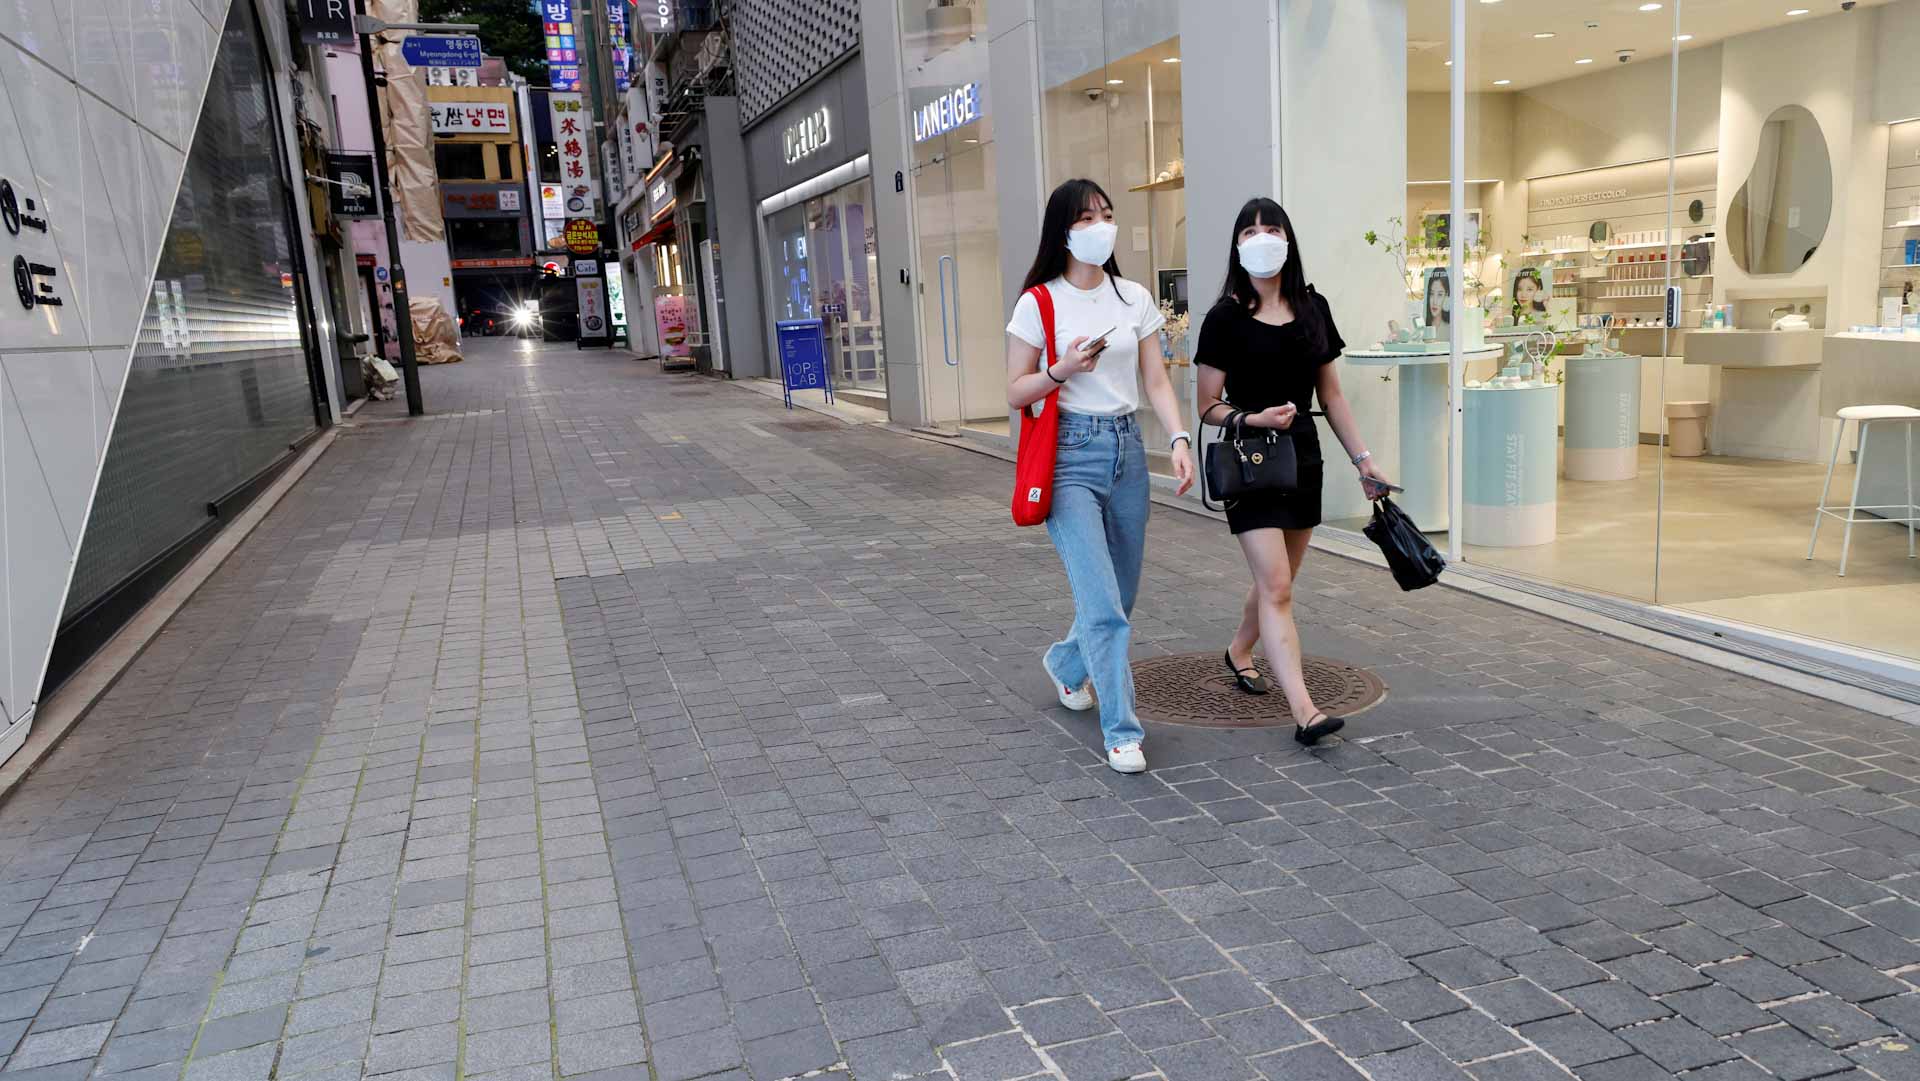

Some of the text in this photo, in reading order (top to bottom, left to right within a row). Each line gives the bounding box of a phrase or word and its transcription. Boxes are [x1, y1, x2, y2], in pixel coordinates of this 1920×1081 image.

[913, 82, 976, 142] LANEIGE
[788, 362, 820, 375] IOPE
[790, 373, 817, 386] LAB
[1504, 432, 1518, 462] STAY
[1504, 463, 1517, 480] FIT
